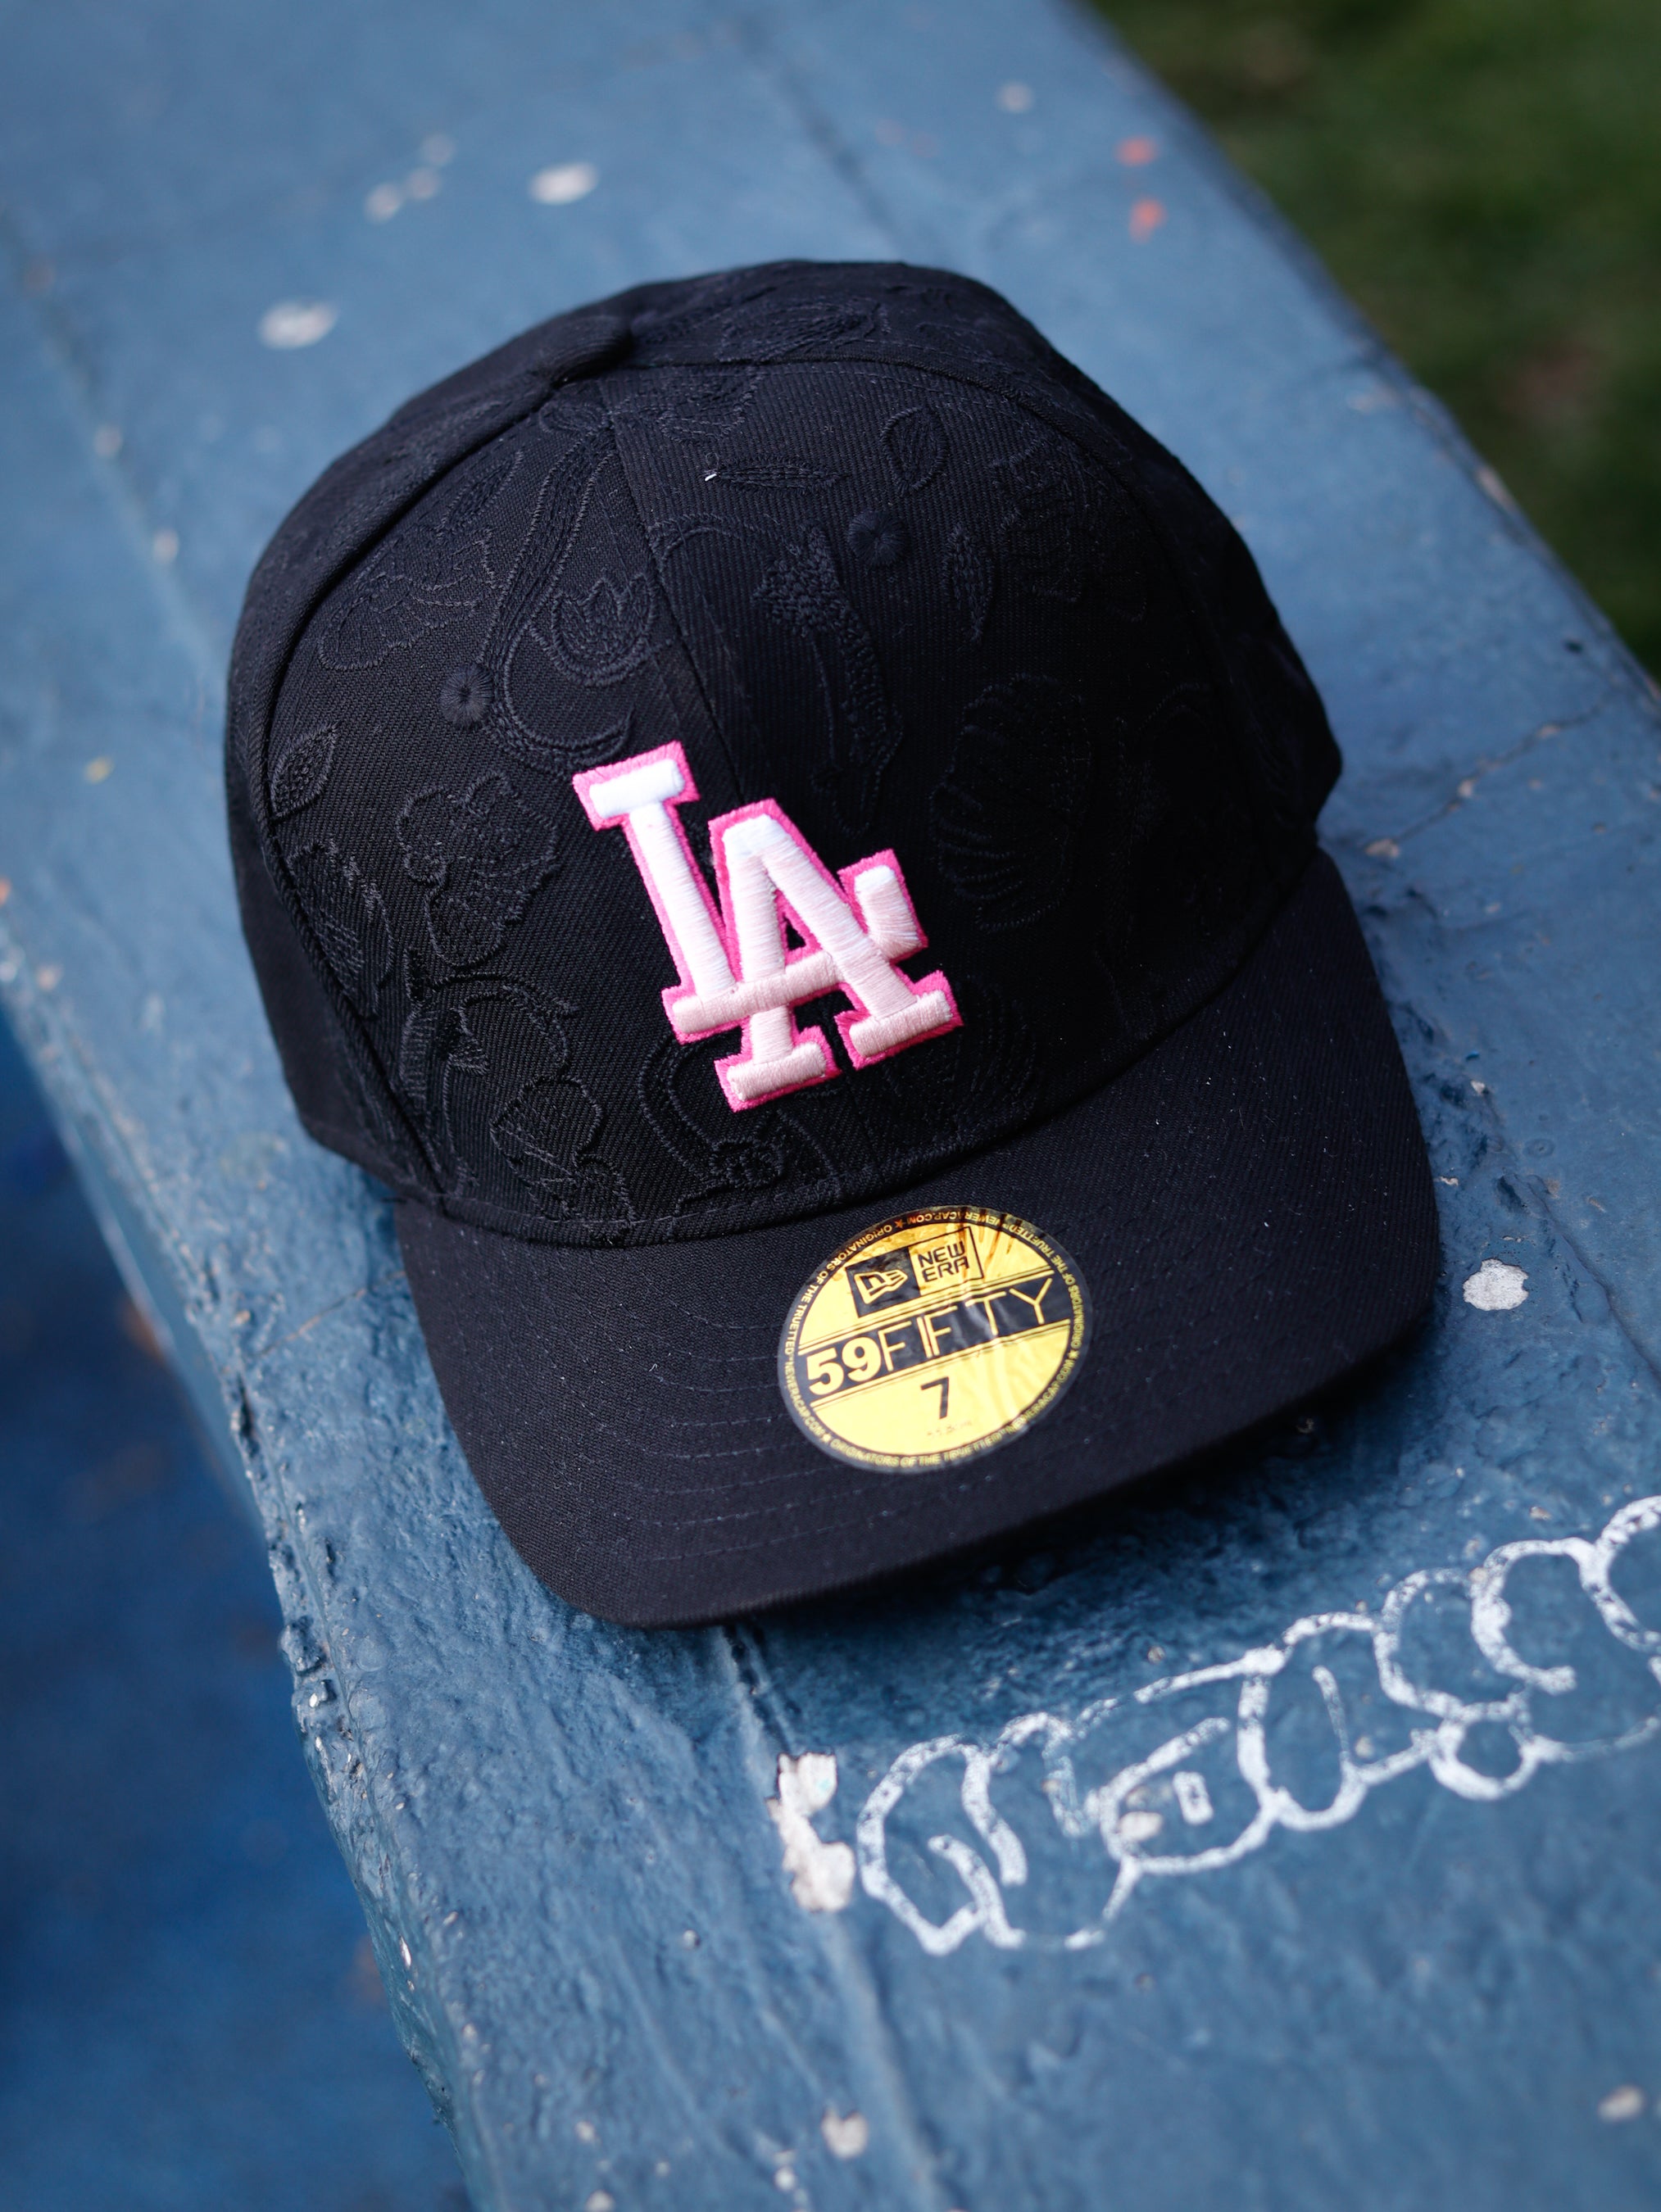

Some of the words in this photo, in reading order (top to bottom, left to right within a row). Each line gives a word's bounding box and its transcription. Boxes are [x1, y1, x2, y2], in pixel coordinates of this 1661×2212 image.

[572, 741, 964, 1113] LA
[825, 1222, 893, 1271] ORIGINATORS
[918, 1241, 964, 1267] NEW
[923, 1258, 970, 1283] ERA
[1050, 1253, 1069, 1273] THE
[814, 1268, 828, 1285] OF
[1060, 1270, 1076, 1285] OF
[800, 1281, 819, 1303] THE
[806, 1278, 1052, 1395] 59FIFTY
[920, 1376, 950, 1419] 7
[918, 1453, 942, 1466] THE
